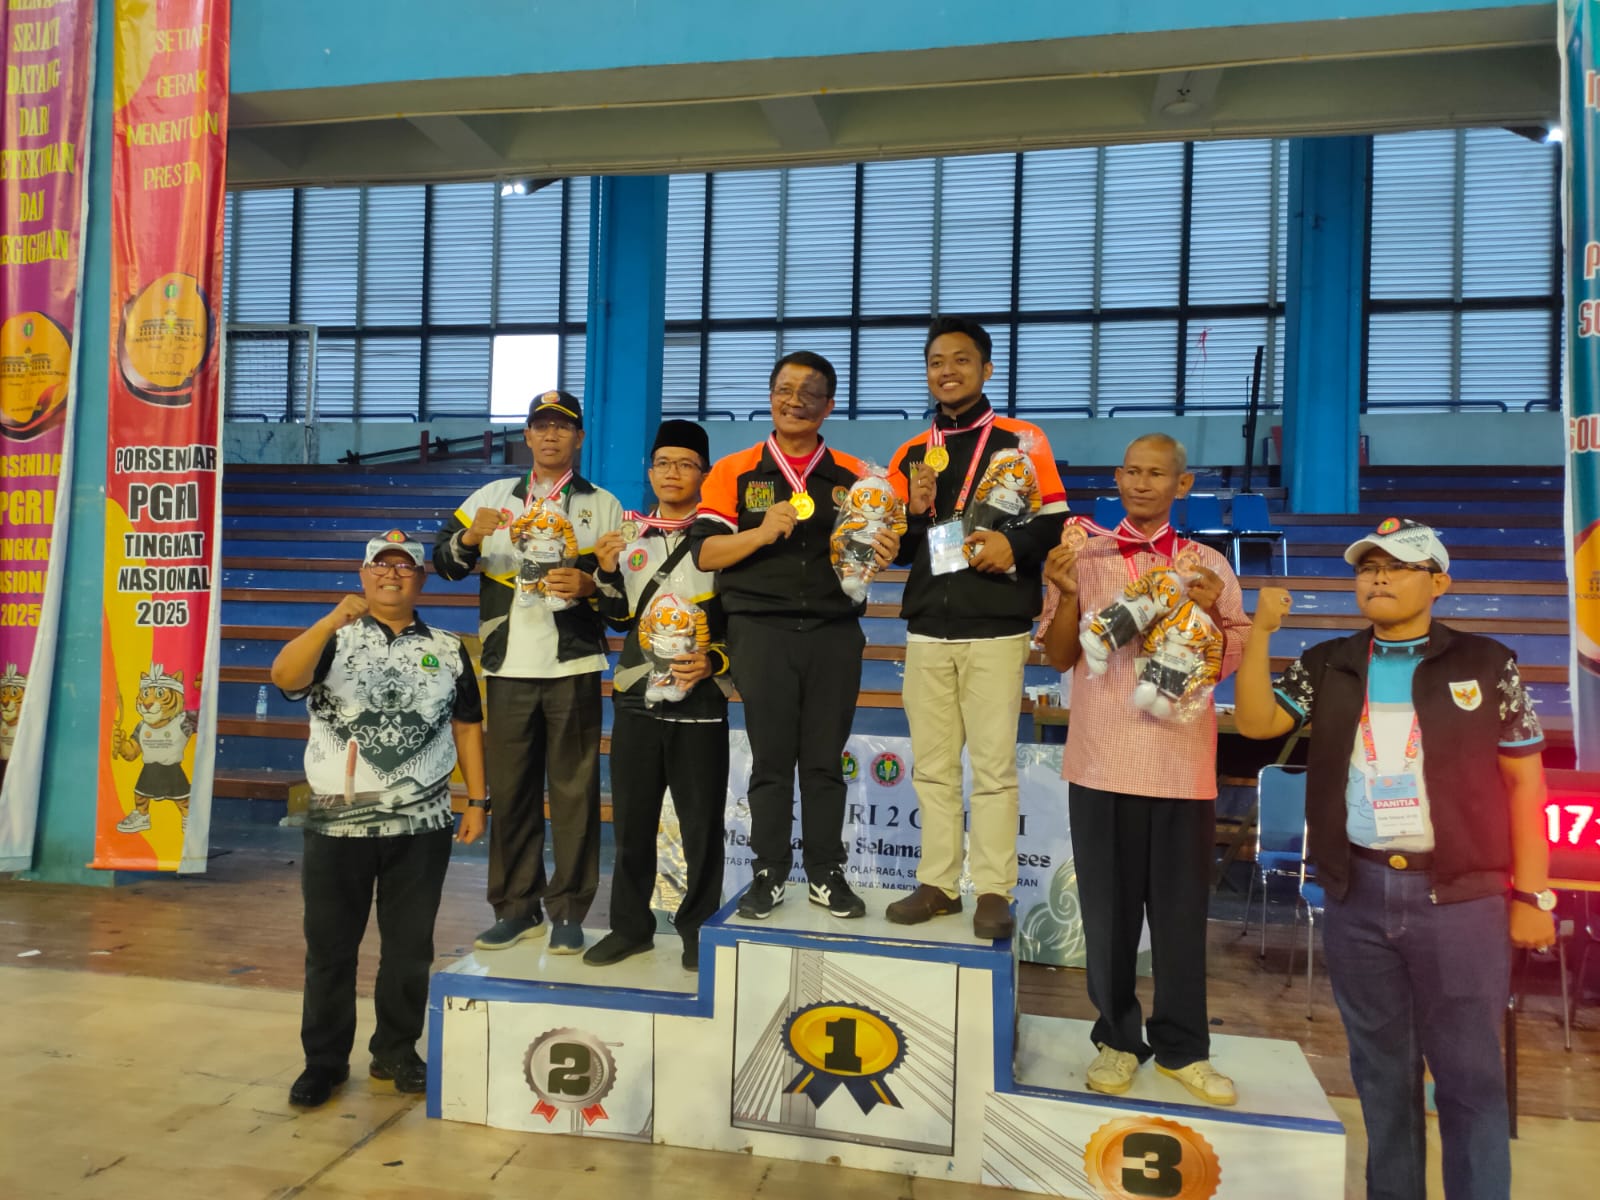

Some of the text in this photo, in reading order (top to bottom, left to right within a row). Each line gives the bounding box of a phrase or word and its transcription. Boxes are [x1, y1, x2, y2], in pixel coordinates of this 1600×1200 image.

[156, 24, 209, 52] SETIAP
[157, 70, 207, 98] GERAK
[0, 490, 56, 525] PGRI
[129, 481, 198, 522] PGRI
[124, 532, 205, 558] TINGKAT
[118, 566, 211, 592] NASIONAL
[1, 603, 42, 626] 2025
[136, 600, 189, 626] 2025
[887, 805, 899, 828] 2
[1376, 799, 1415, 808] PANITIA
[856, 836, 921, 859] Selama
[1017, 853, 1051, 868] ses
[824, 1017, 862, 1073] 1
[548, 1042, 591, 1096] 2
[1122, 1132, 1182, 1198] 3
